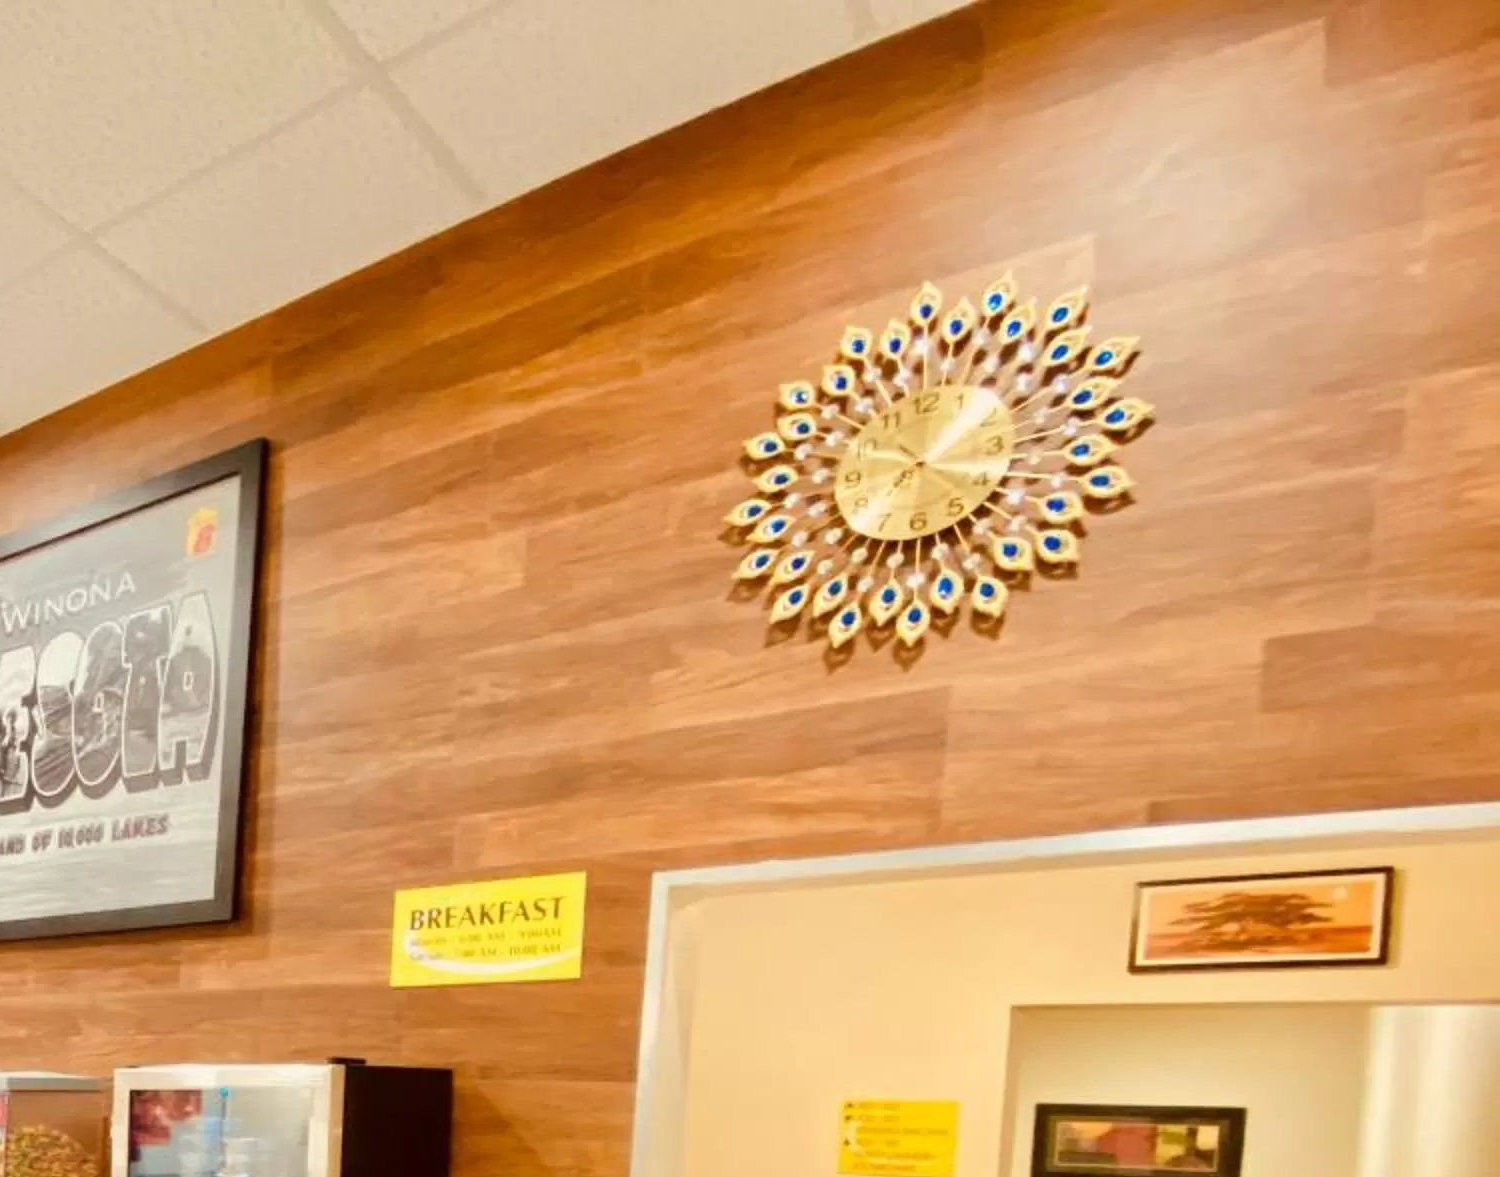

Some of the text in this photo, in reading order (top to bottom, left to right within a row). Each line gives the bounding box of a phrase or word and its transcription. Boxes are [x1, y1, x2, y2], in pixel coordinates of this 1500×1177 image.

[912, 392, 940, 414] 12
[957, 393, 965, 409] 1
[882, 411, 901, 429] 11
[985, 435, 1004, 455] 3
[845, 471, 861, 488] 9
[972, 471, 990, 486] 4
[947, 497, 964, 516] 5
[878, 512, 892, 532] 7
[909, 512, 927, 531] 6
[2, 571, 135, 633] WINONA
[31, 828, 52, 851] OF
[111, 813, 169, 842] LAKES
[409, 896, 567, 931] BREAKFAST
